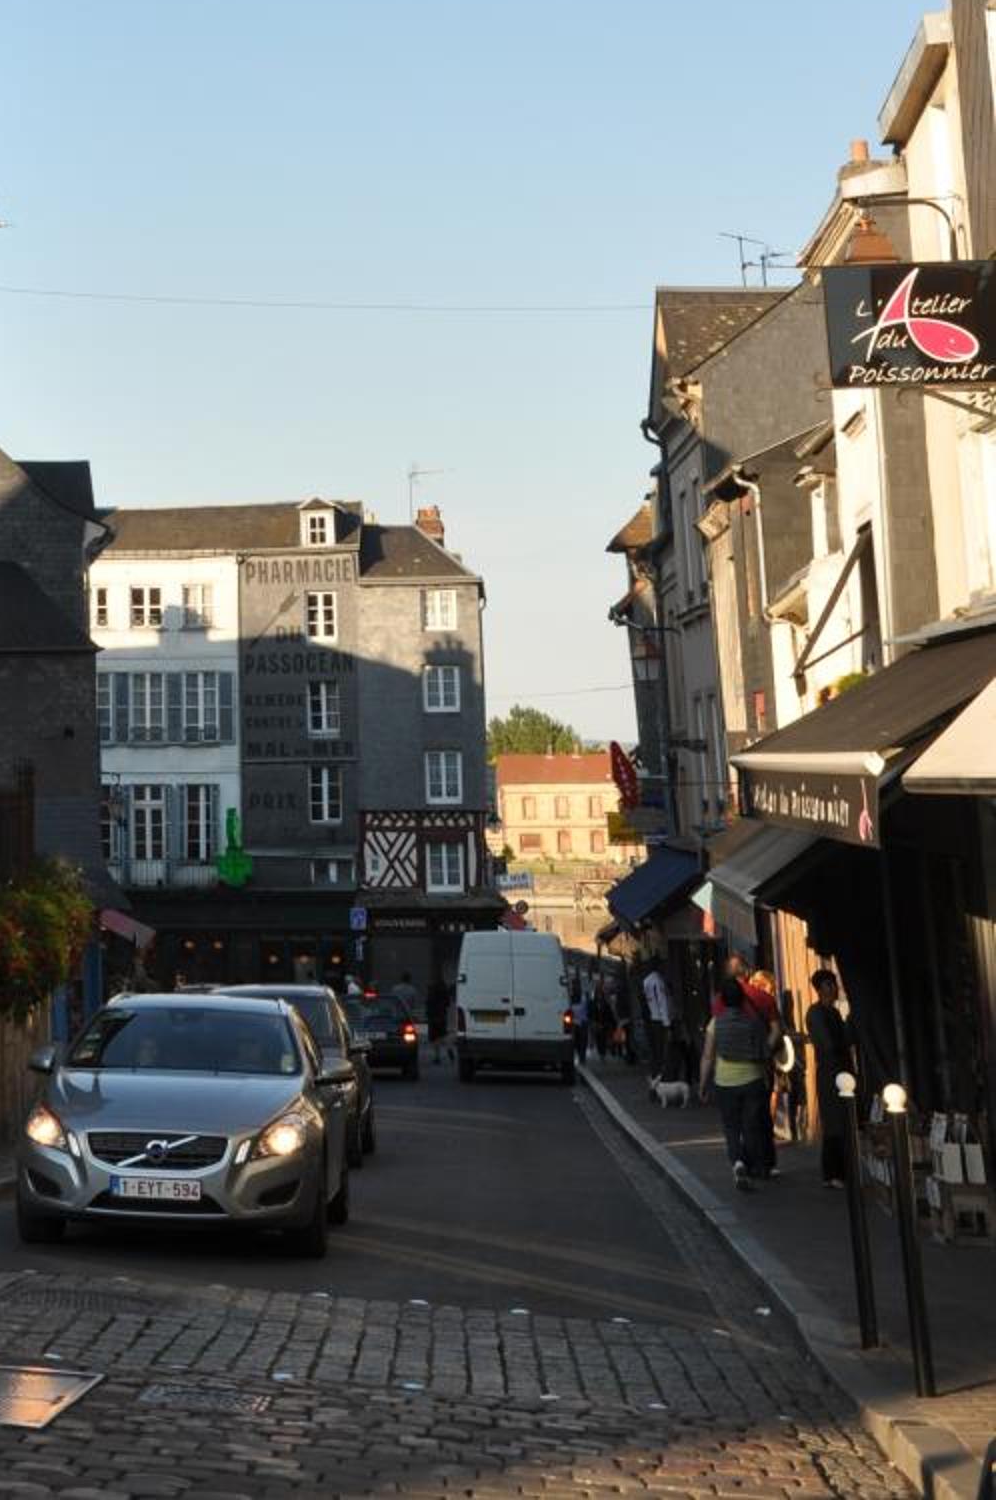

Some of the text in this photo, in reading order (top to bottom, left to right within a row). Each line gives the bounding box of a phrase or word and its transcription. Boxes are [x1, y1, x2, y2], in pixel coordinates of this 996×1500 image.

[851, 267, 972, 348] L'Atelier
[876, 329, 908, 349] du
[849, 360, 996, 383] Poissonnier
[245, 558, 352, 585] PHARMACIE
[276, 625, 300, 641] DU
[247, 740, 290, 756] MAL
[313, 740, 354, 756] MER
